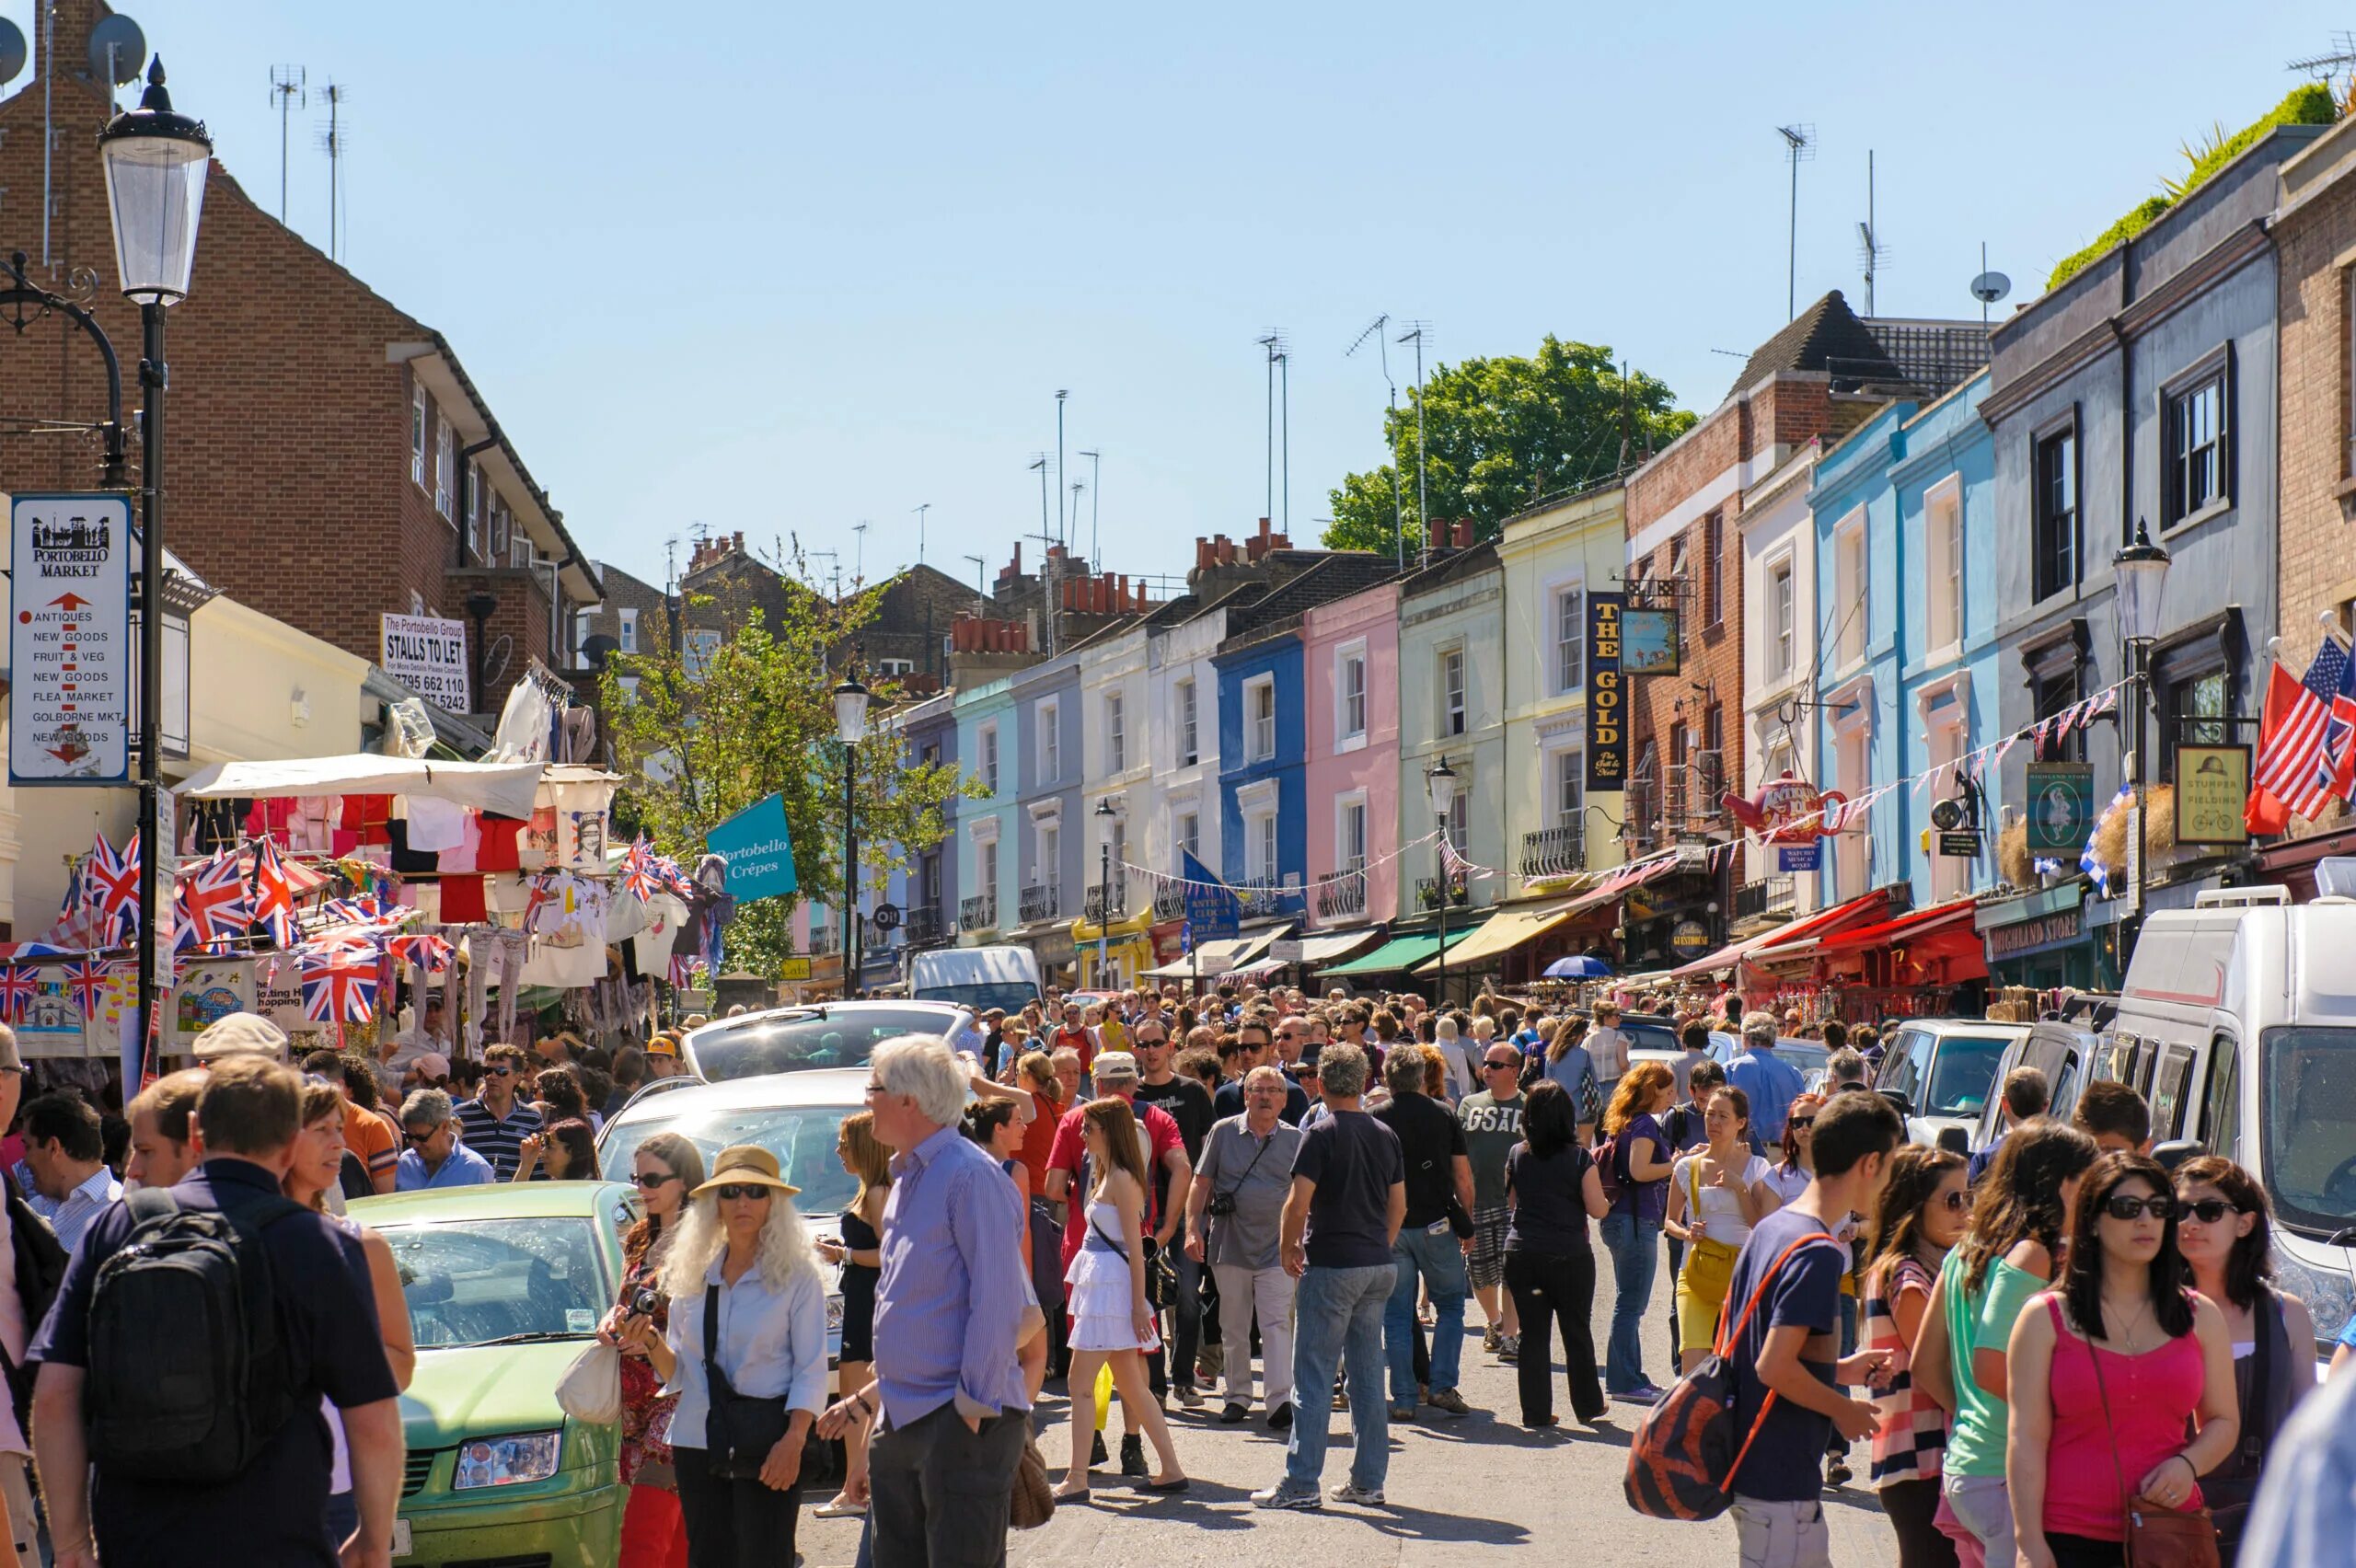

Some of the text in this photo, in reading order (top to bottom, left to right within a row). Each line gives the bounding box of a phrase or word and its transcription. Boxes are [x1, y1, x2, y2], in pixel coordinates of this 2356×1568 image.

[33, 549, 109, 562] PORTOBELLO
[40, 564, 99, 577] MARKET
[34, 612, 92, 622] ANTIQUES
[386, 617, 463, 640] The Portobello Group
[1595, 603, 1619, 657] THE
[33, 632, 108, 641] NEW GOODS
[387, 634, 462, 664] STALLS TO LET
[33, 651, 105, 662] FRUIT & VEG
[397, 663, 410, 671] More
[410, 663, 427, 672] Details
[428, 664, 444, 673] Please
[33, 673, 109, 682] NEW GOODS
[390, 674, 464, 693] 795 662 110
[33, 692, 114, 702] FLEA MARKET
[440, 695, 465, 710] 5242
[1595, 671, 1619, 744] GOLD
[32, 712, 121, 722] GOLBORNE MKT
[33, 732, 109, 742] NEW GOODS
[2188, 780, 2236, 789] STUMPER
[2188, 796, 2237, 804] FIELDING
[716, 839, 788, 862] Portobello
[732, 862, 779, 879] Crêpes
[877, 910, 897, 923] Oi!
[1992, 914, 2078, 953] HIGHLAND STORE
[1673, 935, 1709, 946] GUESTHOUSE
